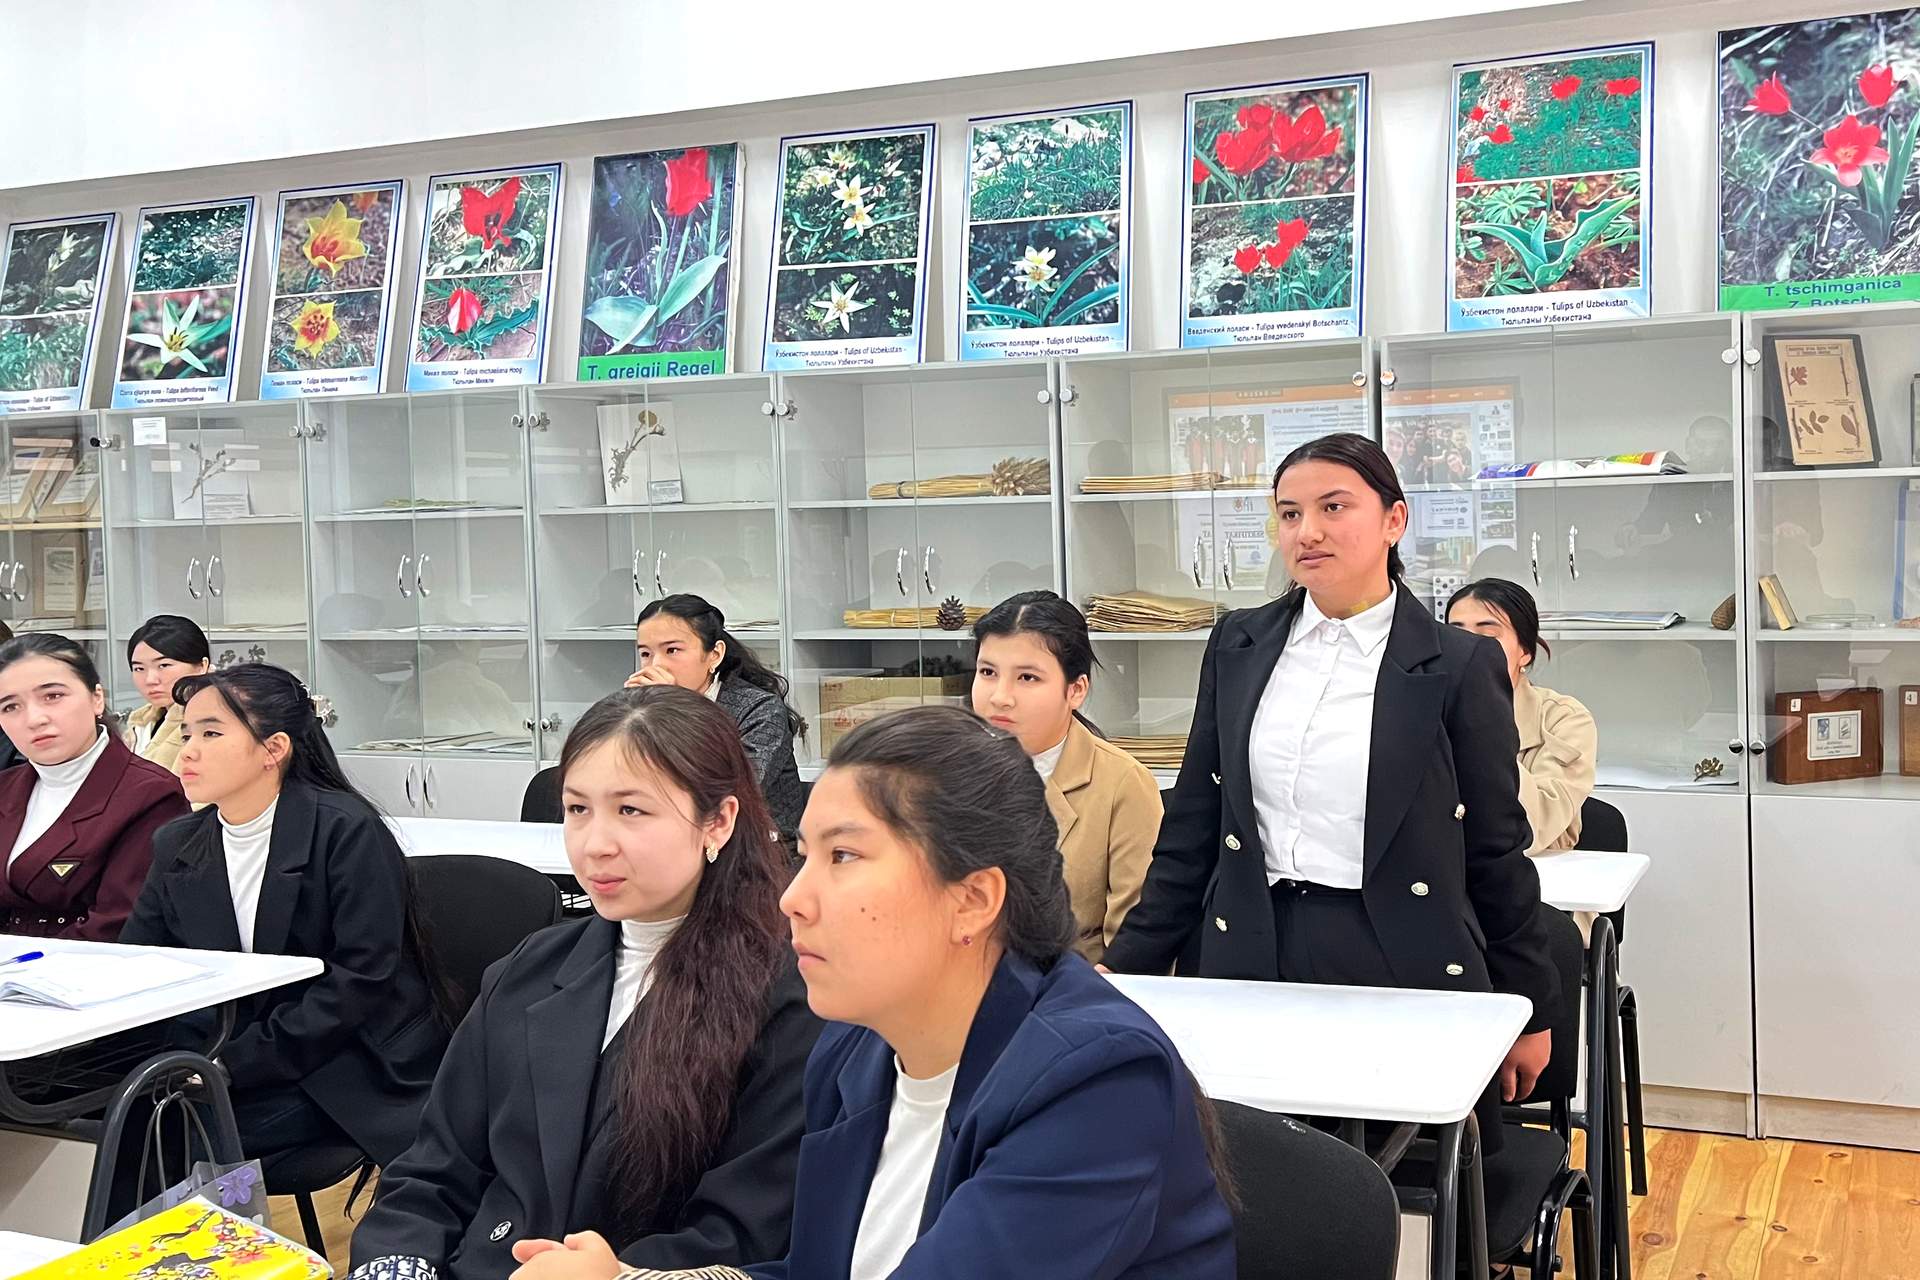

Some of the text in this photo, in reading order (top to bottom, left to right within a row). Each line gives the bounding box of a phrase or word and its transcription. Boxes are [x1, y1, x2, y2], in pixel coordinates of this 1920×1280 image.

[1764, 279, 1902, 297] T. tschimganica
[1551, 302, 1574, 312] Tulips
[1575, 301, 1584, 310] of
[1586, 299, 1628, 309] Uzbekistan
[587, 364, 601, 380] T.
